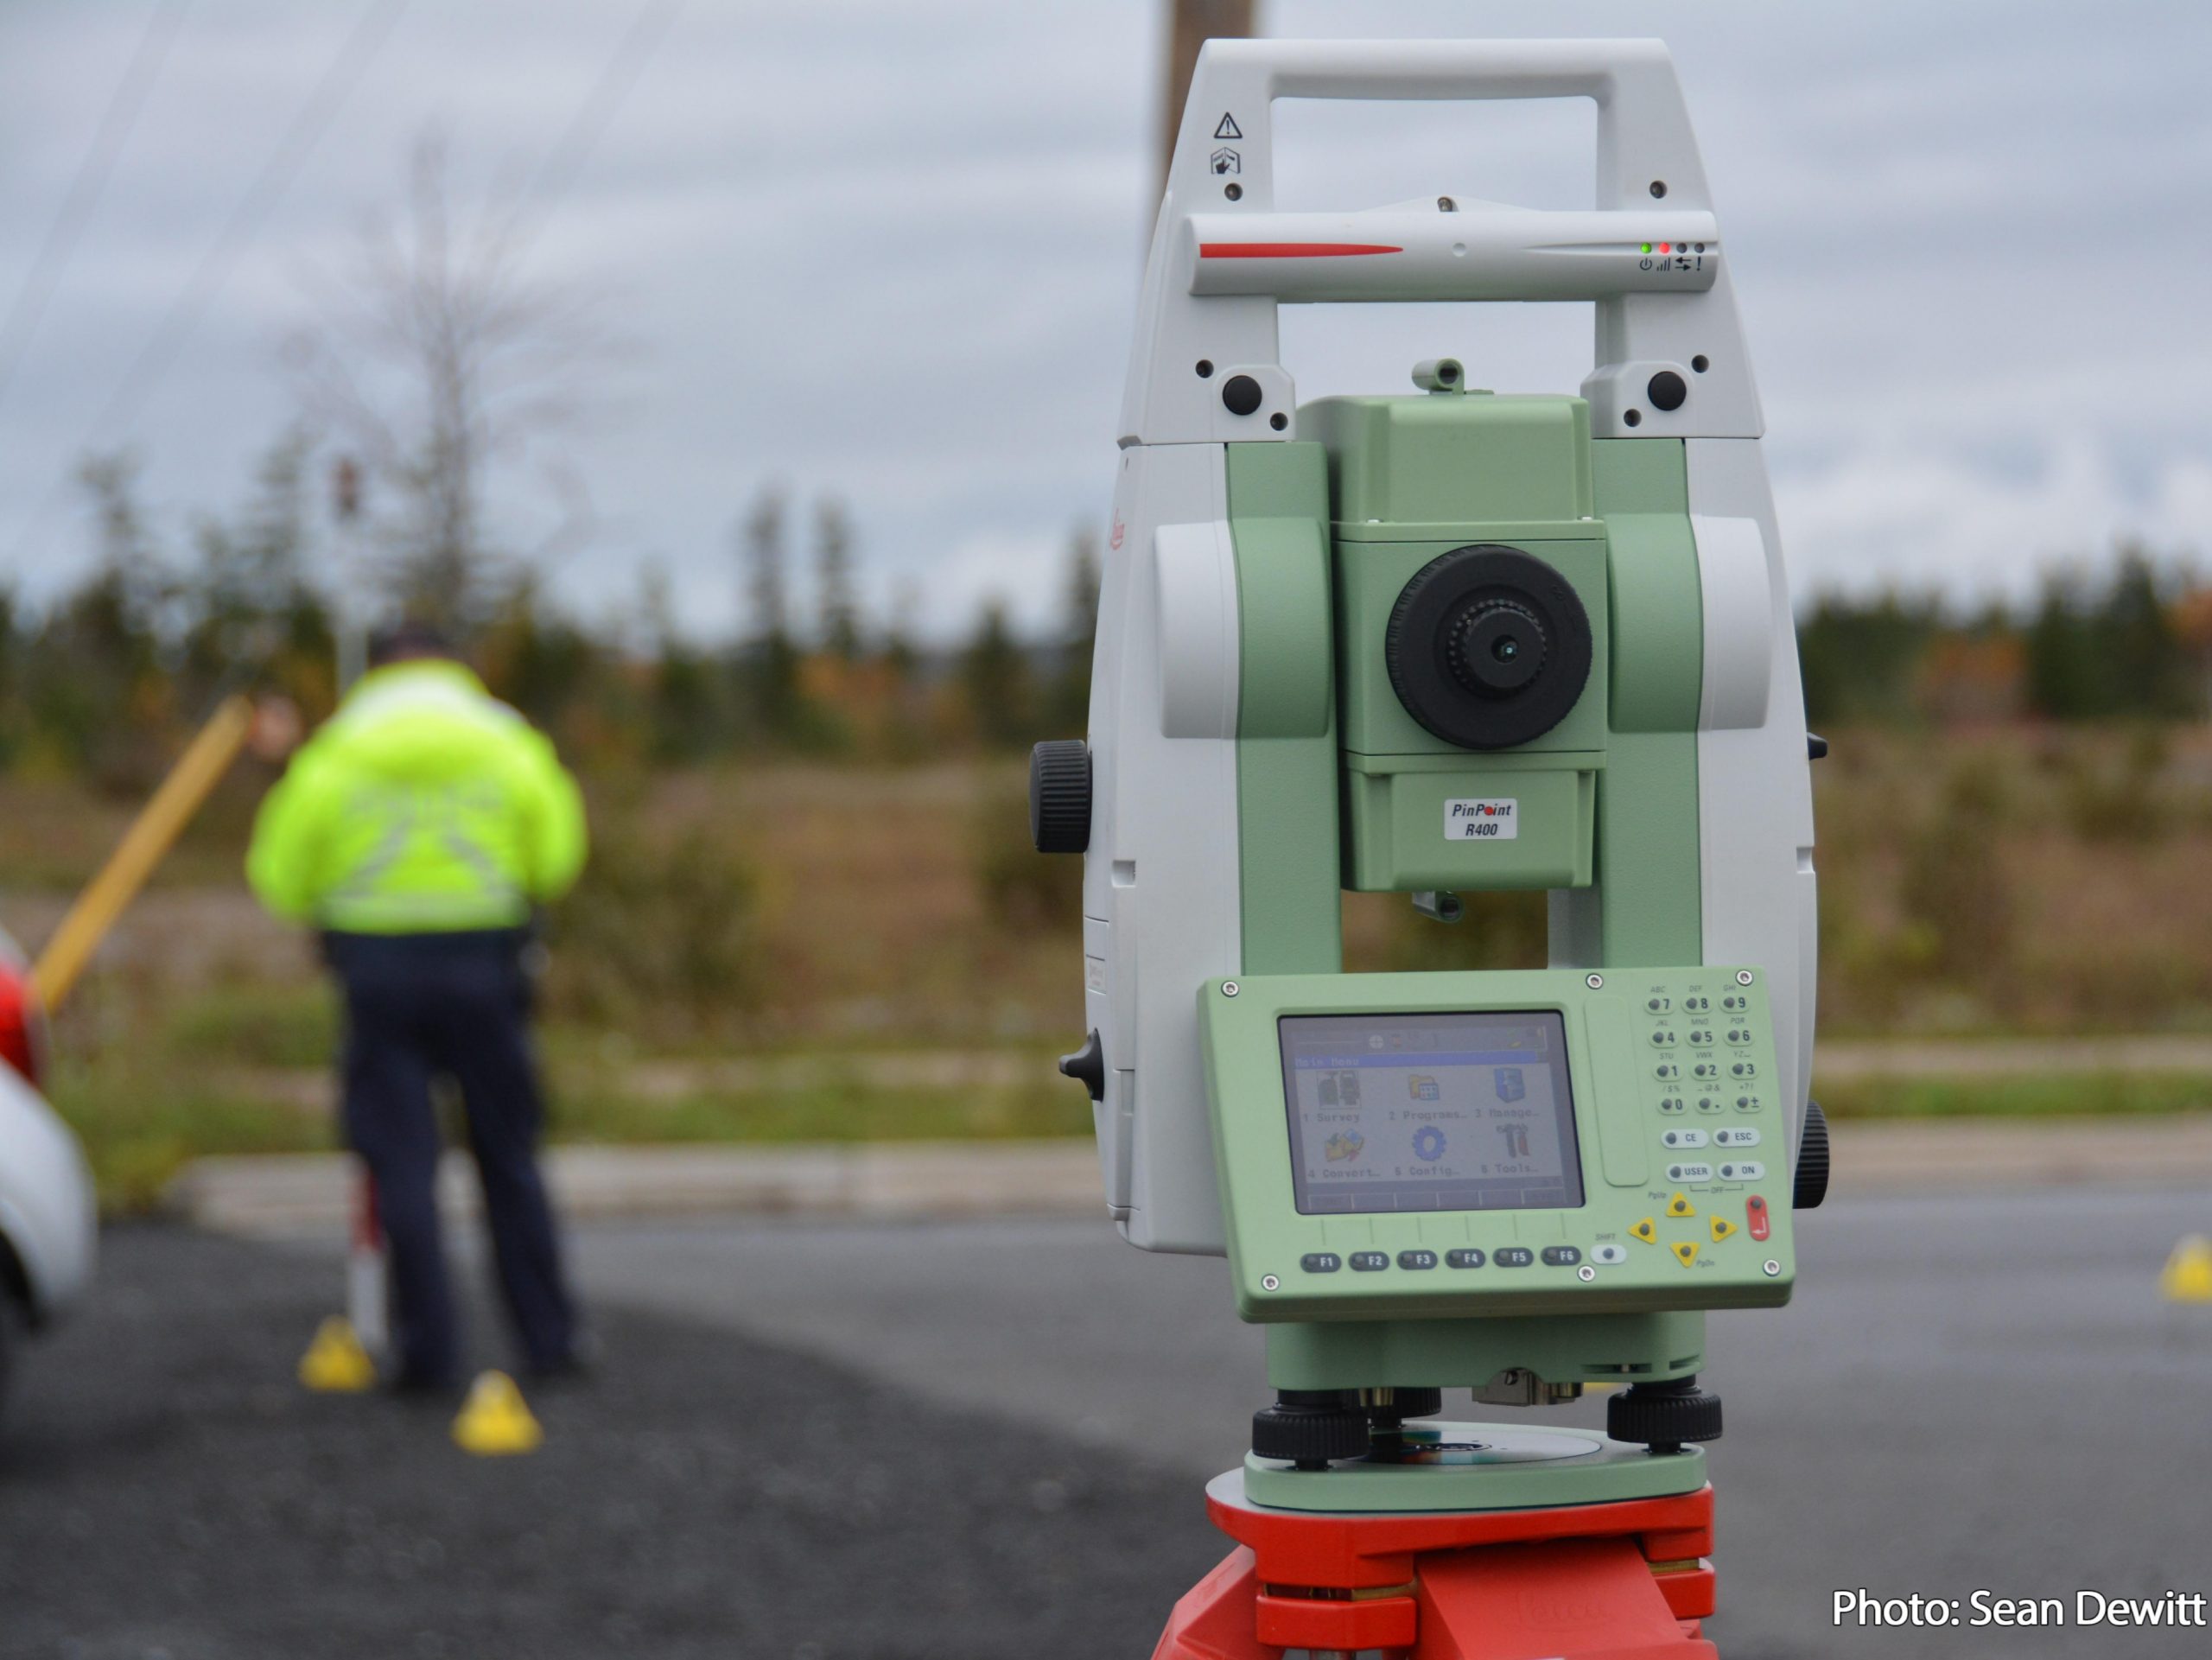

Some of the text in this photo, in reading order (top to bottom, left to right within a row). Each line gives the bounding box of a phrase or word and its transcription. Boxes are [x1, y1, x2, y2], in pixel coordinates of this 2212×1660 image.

[1452, 803, 1512, 817] PinPoint
[1465, 824, 1498, 836] R400
[1662, 998, 1670, 1010] 7
[1700, 997, 1708, 1009] 8
[1738, 996, 1746, 1008] 9
[1667, 1032, 1675, 1043] 4
[1704, 1031, 1713, 1042] 5
[1742, 1030, 1751, 1041] 6
[1331, 1057, 1360, 1066] Menu
[1671, 1065, 1678, 1077] 1
[1708, 1065, 1717, 1076] 2
[1746, 1064, 1755, 1075] 3
[1675, 1098, 1683, 1110] 0
[1303, 1113, 1360, 1123] 1 Survey
[1389, 1110, 1396, 1121] 2
[1475, 1109, 1482, 1118] 3
[1685, 1133, 1697, 1142] CE
[1734, 1132, 1752, 1142] ESC
[1684, 1167, 1708, 1176] USER
[1741, 1166, 1755, 1175] ON
[1648, 1191, 1667, 1199] PgUp
[1368, 1256, 1382, 1267] F2
[1415, 1254, 1431, 1265] F3
[1464, 1253, 1478, 1264] F4
[1512, 1251, 1526, 1262] F5
[1560, 1250, 1574, 1262] F6
[1319, 1256, 1333, 1268] F1
